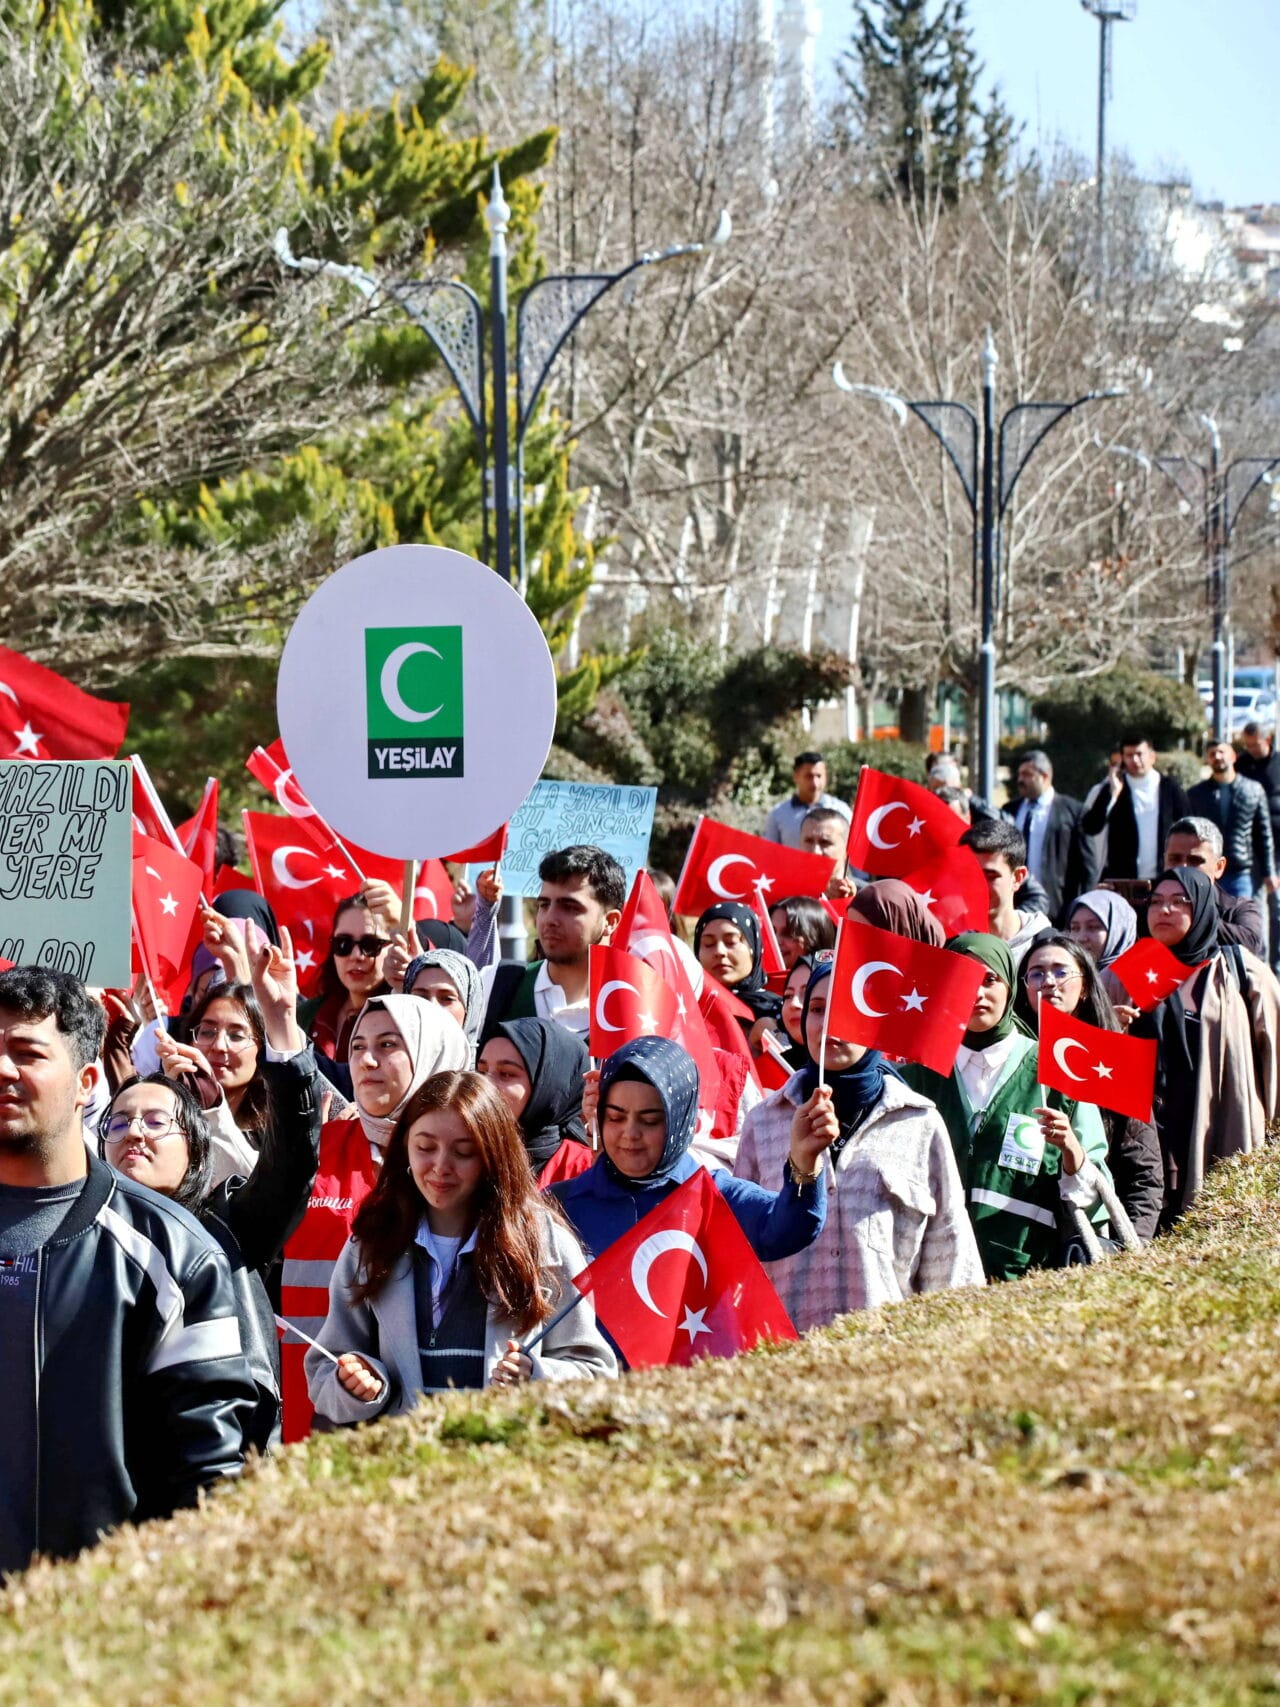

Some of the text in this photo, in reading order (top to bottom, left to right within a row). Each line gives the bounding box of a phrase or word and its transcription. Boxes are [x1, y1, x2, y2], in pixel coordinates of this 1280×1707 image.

[374, 747, 457, 772] YEŞİLAY
[564, 785, 651, 815] YAZILDI
[58, 810, 107, 853] Mİ
[0, 853, 103, 900] YERE
